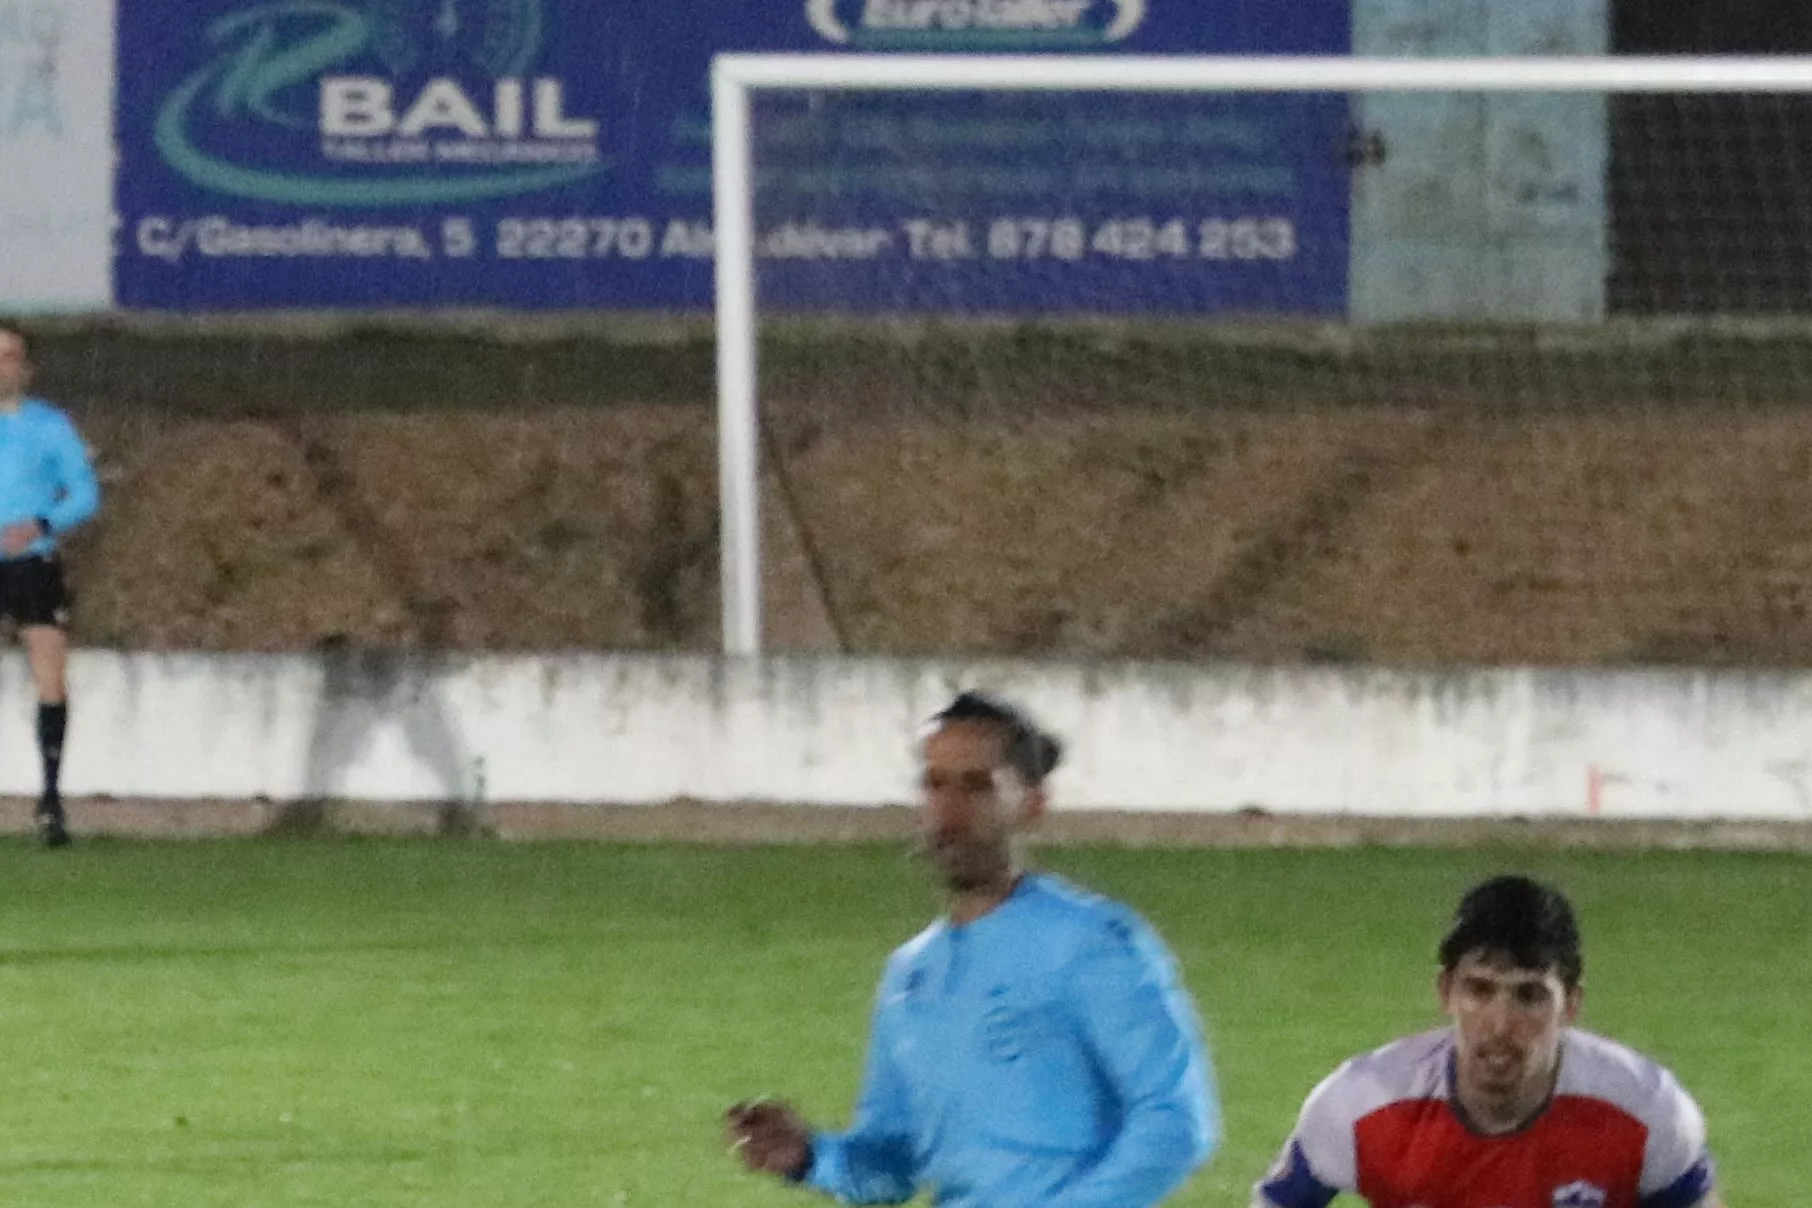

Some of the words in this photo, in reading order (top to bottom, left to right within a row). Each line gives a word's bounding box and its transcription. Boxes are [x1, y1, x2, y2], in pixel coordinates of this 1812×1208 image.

[319, 75, 601, 138] BAIL
[442, 216, 475, 258] 5
[496, 216, 654, 260] 22270
